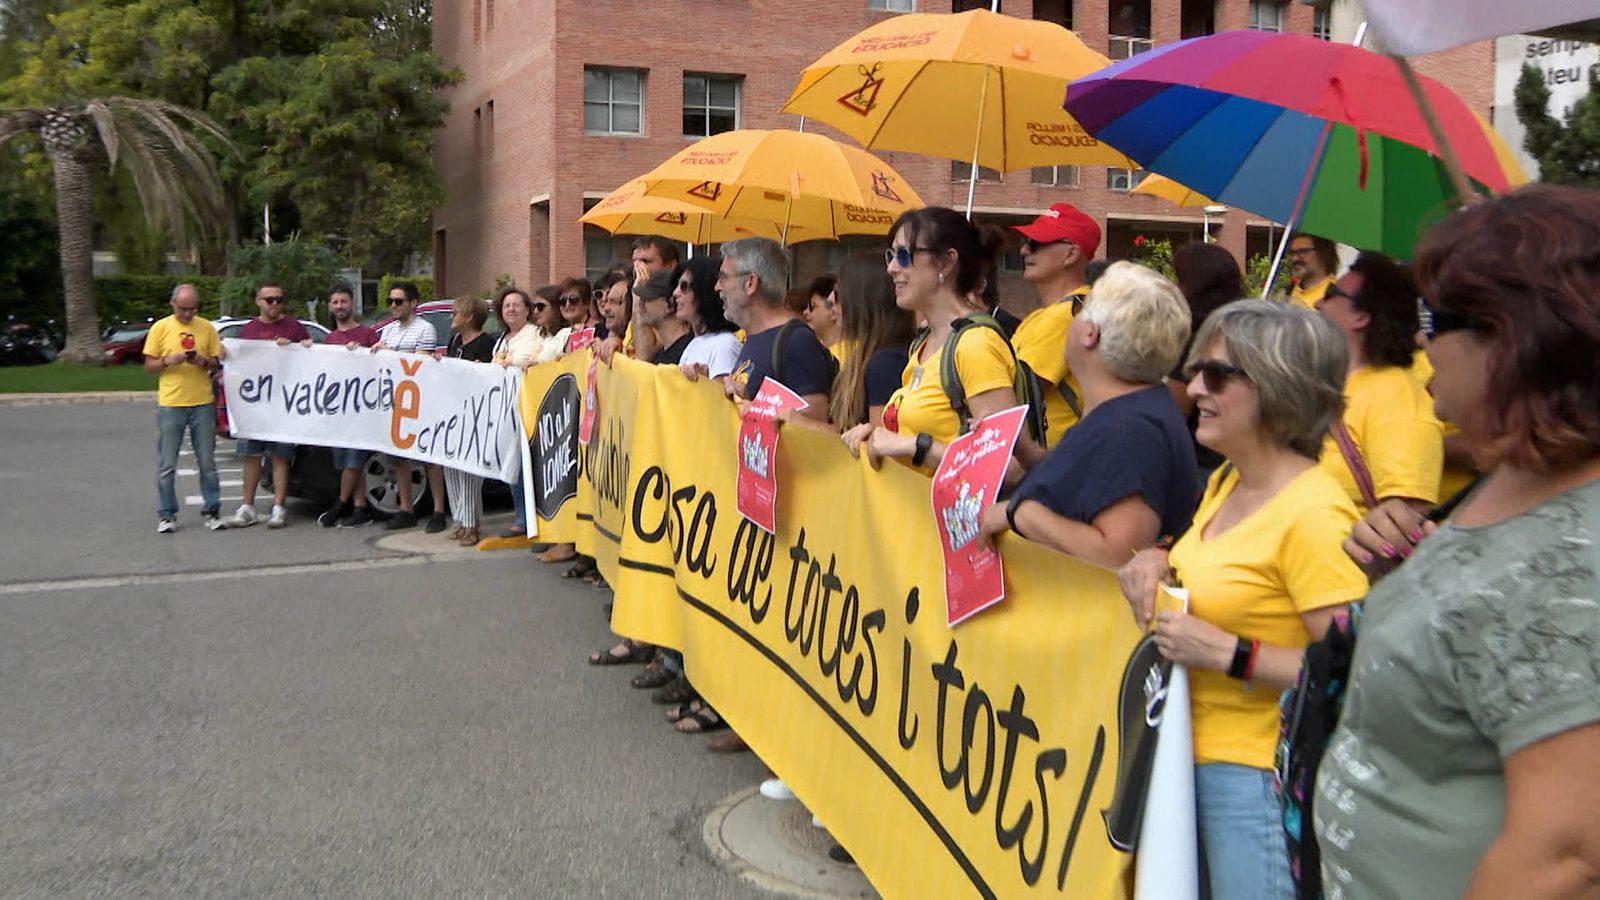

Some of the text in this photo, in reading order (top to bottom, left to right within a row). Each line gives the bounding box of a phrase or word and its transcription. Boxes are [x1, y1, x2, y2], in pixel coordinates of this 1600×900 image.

[239, 371, 273, 402] en
[538, 412, 554, 457] NO
[632, 466, 717, 578] csa
[783, 527, 885, 716] totes
[899, 587, 919, 750] i
